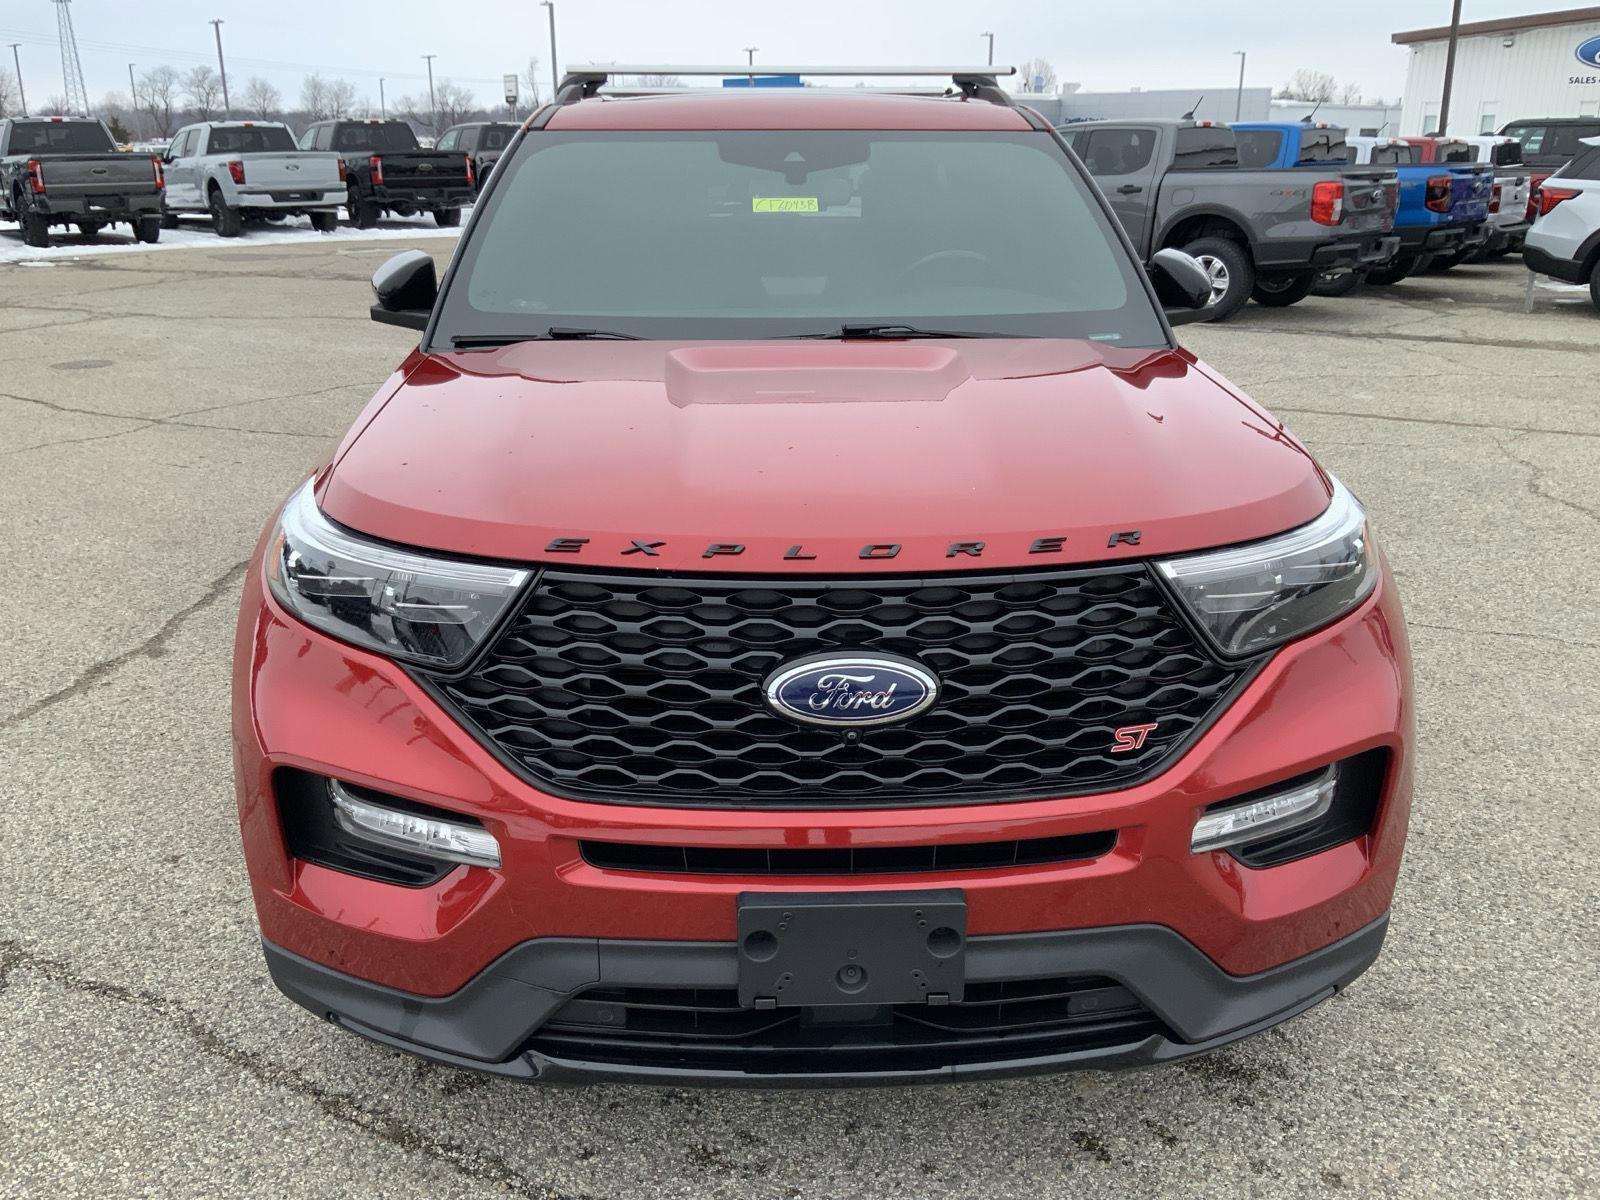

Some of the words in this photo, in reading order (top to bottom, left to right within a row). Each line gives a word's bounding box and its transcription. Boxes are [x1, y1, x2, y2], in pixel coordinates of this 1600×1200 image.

[1569, 76, 1597, 84] SALES
[544, 530, 1142, 560] EXPLORER
[808, 673, 898, 711] Ford
[1111, 722, 1159, 753] ST
